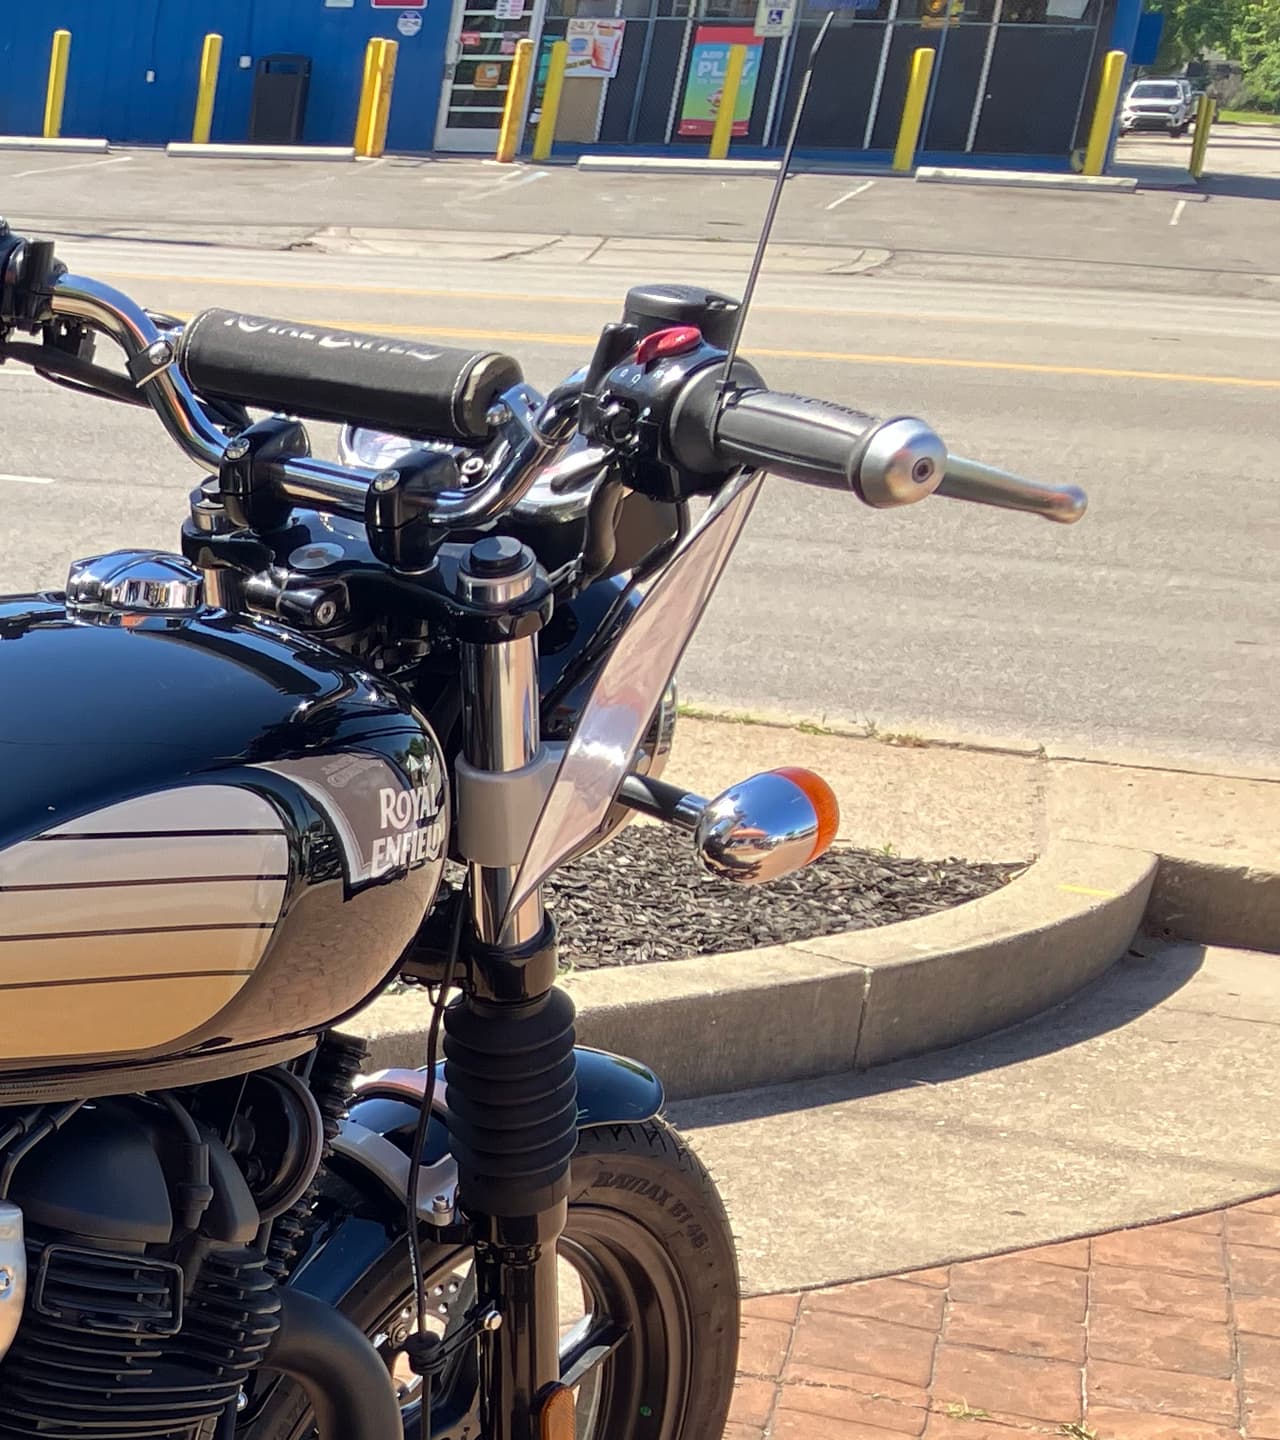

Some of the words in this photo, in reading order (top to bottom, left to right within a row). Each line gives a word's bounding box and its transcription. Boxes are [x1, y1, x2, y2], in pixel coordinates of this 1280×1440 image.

[697, 60, 755, 77] PLY
[379, 783, 440, 830] ROYAL
[371, 822, 446, 878] ENFIELD
